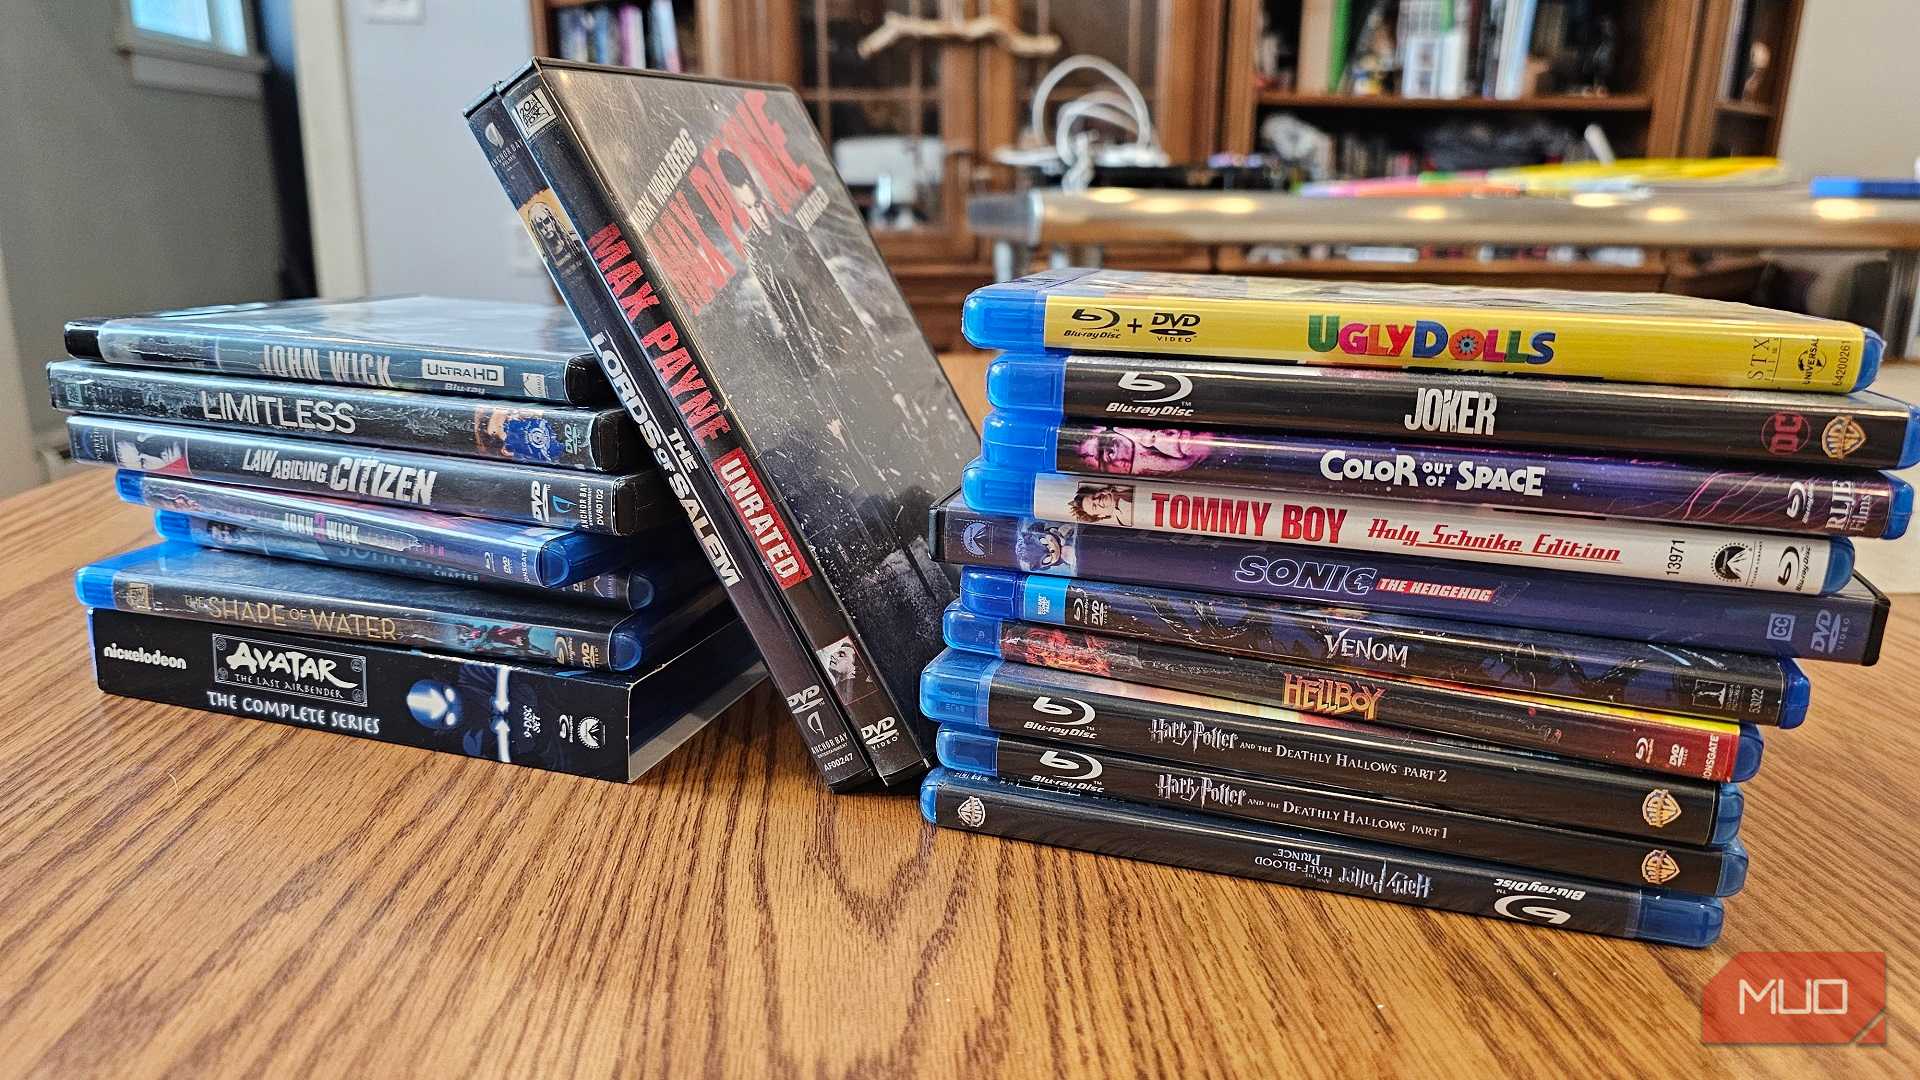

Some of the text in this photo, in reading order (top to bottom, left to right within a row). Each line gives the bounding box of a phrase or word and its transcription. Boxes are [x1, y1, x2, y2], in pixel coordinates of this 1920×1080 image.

[628, 127, 699, 234] MARK WAHLBERG
[645, 191, 737, 316] MAX
[586, 223, 731, 448] MAX PAYNE
[1064, 329, 1121, 339] Blu-ray Disc
[1151, 312, 1200, 328] DVD
[1156, 335, 1192, 343] VIDEO
[258, 344, 396, 388] JOHN WICK
[1747, 338, 1770, 380] STX
[1802, 337, 1820, 385] UNIVERSAL
[444, 383, 486, 395] Blu-ray
[200, 390, 356, 434] LIMITLESS
[1105, 402, 1195, 417] Blu-ray Disc
[1404, 387, 1498, 436] JOKER
[667, 427, 699, 473] THE
[1770, 411, 1802, 455] DC
[242, 448, 438, 505] LAW ABIDING CITIZEN
[590, 331, 663, 449] LORDS
[669, 472, 742, 588] SALEM
[1319, 450, 1546, 497] COLOR OUT OF SPACE
[531, 481, 543, 521] DVD
[579, 482, 590, 529] ANCHOR BAY
[720, 457, 800, 579] UNRATED
[1151, 492, 1348, 544] TOMMY BOY
[1849, 495, 1872, 531] Films
[284, 512, 314, 536] JOHN
[326, 519, 359, 545] WICK
[1367, 518, 1622, 561] Holy Schnike Edition
[433, 569, 480, 583] CHAPTER
[1665, 540, 1686, 576] 13971
[1234, 555, 1494, 602] SONIC THE HEDGEHOG
[184, 595, 397, 641] THE SHAPE OF WATER
[1091, 599, 1100, 625] DVD
[1810, 608, 1832, 653] DVD
[103, 643, 187, 670] nickelodeon
[225, 642, 359, 689] AVATAR
[581, 642, 591, 668] DVD
[1324, 628, 1409, 668] VENOM
[234, 673, 344, 699] THE LAST AIRBENDER
[786, 685, 820, 708] DVD
[1283, 672, 1388, 721] HELLBOY
[206, 690, 381, 735] THE COMPLETE SERIES
[522, 705, 533, 739] 9-DISC
[532, 713, 541, 734] SET
[860, 716, 896, 740] DVD
[1023, 721, 1097, 739] Blu-ray Disc
[811, 732, 849, 755] ANCHOR BAY
[824, 752, 854, 772] AF00247
[871, 736, 898, 750] VIDEO
[1148, 718, 1192, 746] Harry
[1192, 720, 1239, 752] Potter
[1276, 744, 1332, 764] DEATHLY
[1335, 753, 1398, 774] HALLOWS
[1404, 766, 1436, 781] PART
[1438, 769, 1448, 783] 2
[1669, 744, 1680, 767] DVD
[1030, 775, 1105, 793] Blu-ray Disc
[1155, 774, 1200, 802] Harry
[1200, 776, 1247, 808] Potter
[1248, 798, 1264, 806] AND
[1282, 800, 1341, 821] DEATHLY
[1343, 810, 1406, 832] HALLOWS
[1411, 825, 1440, 837] PART
[1442, 827, 1448, 839] 1
[1254, 856, 1333, 878] HALF-BLOOD
[1276, 848, 1321, 867] PRINCE
[1338, 859, 1435, 899] Harry Potter
[1493, 878, 1586, 901] Blu-ray Disc
